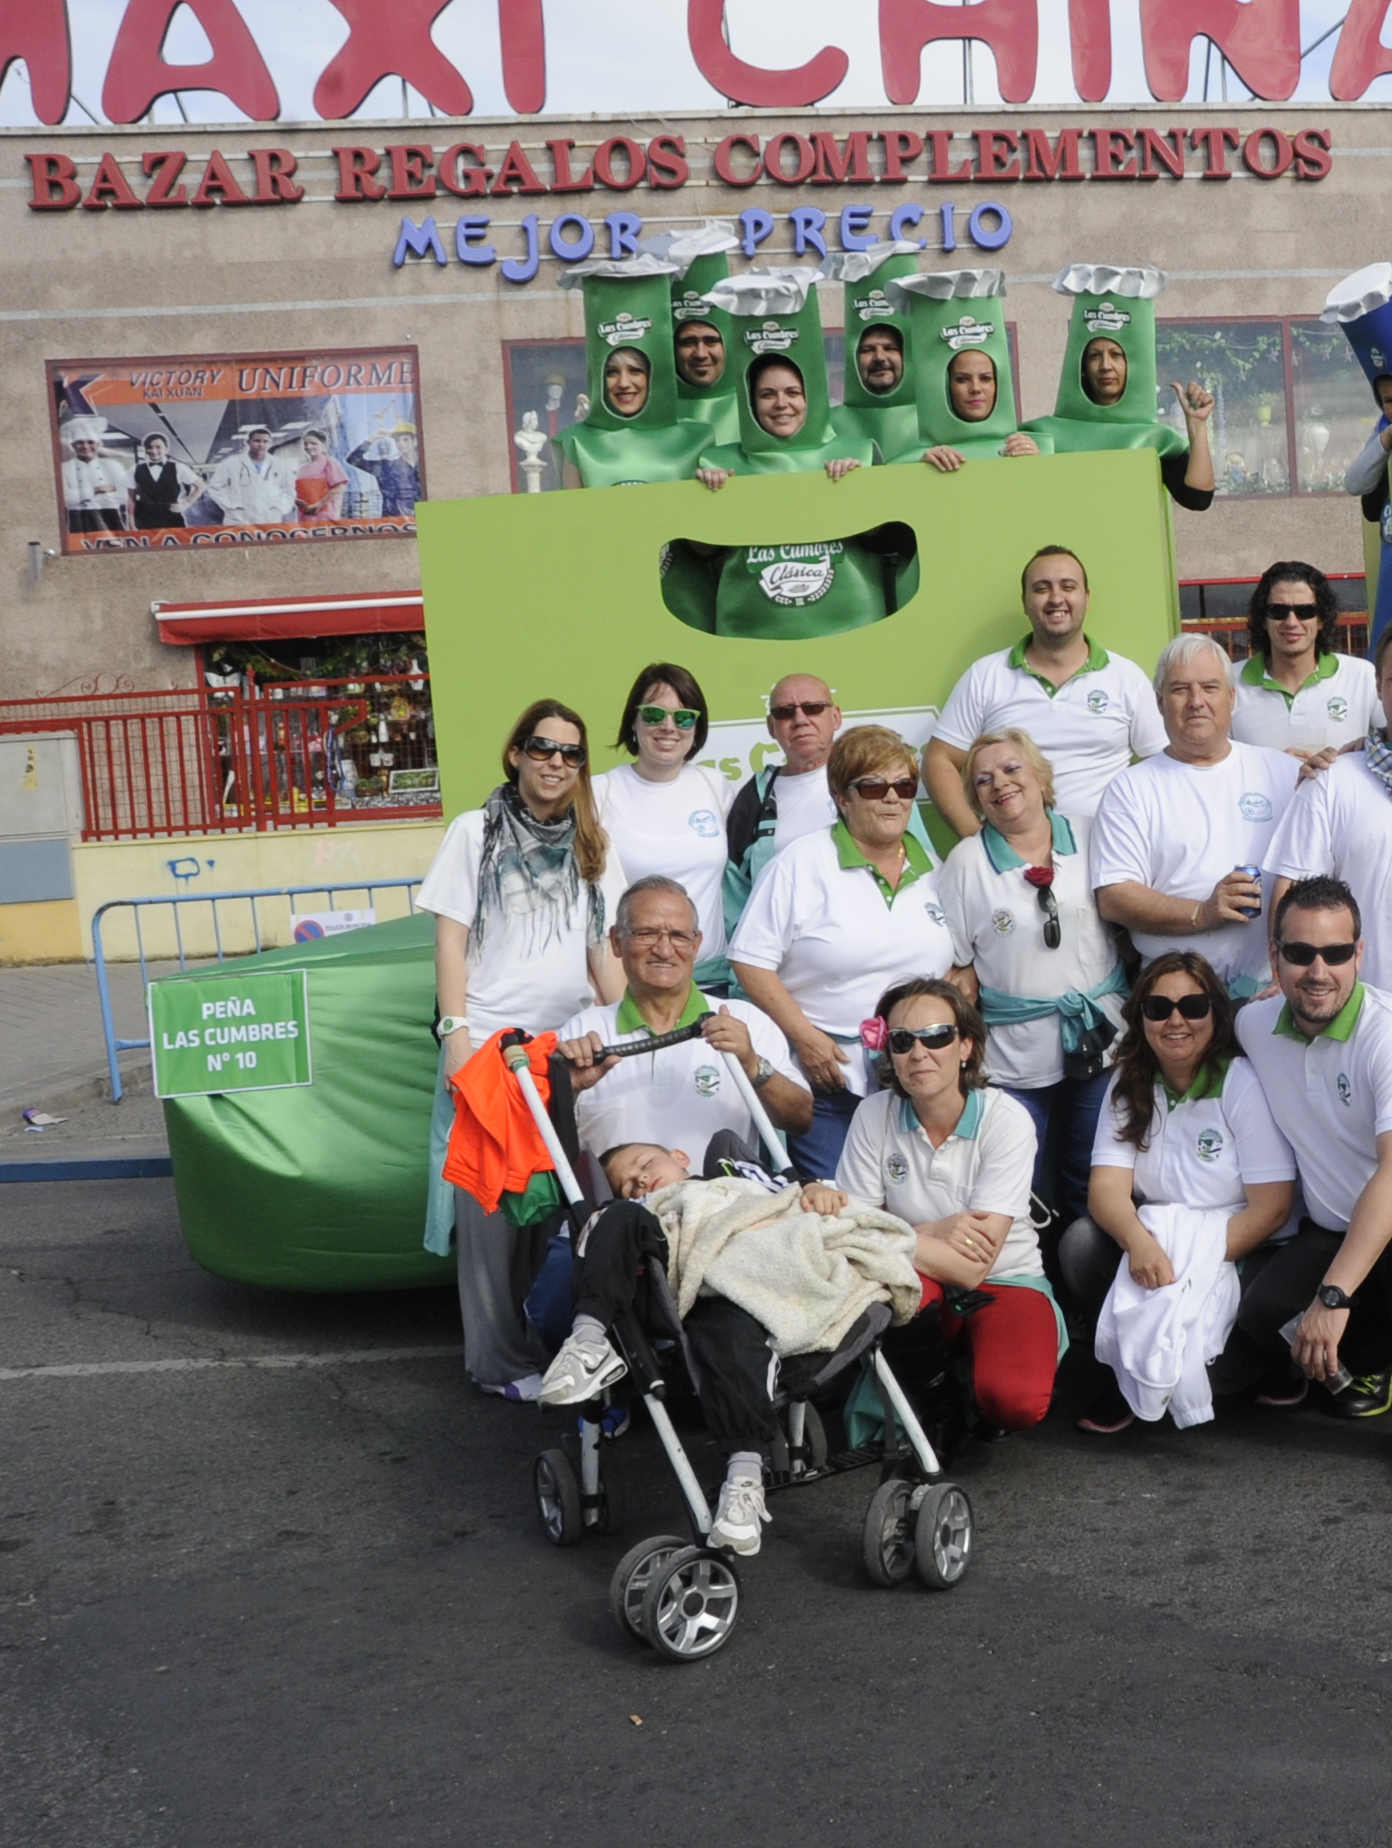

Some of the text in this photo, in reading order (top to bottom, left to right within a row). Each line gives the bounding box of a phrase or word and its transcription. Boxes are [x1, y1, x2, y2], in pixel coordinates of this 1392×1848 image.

[24, 126, 1334, 212] BAZAR REGALOS COMPLEMENTOS
[392, 202, 1013, 284] MEJOR PRECIO
[129, 367, 226, 390] VICTORY
[142, 384, 206, 400] KAI XUAN
[746, 546, 776, 564] Las
[201, 995, 257, 1020] PEÑA
[162, 1020, 299, 1050] LAS CUMBRES
[235, 1051, 257, 1069] 10
